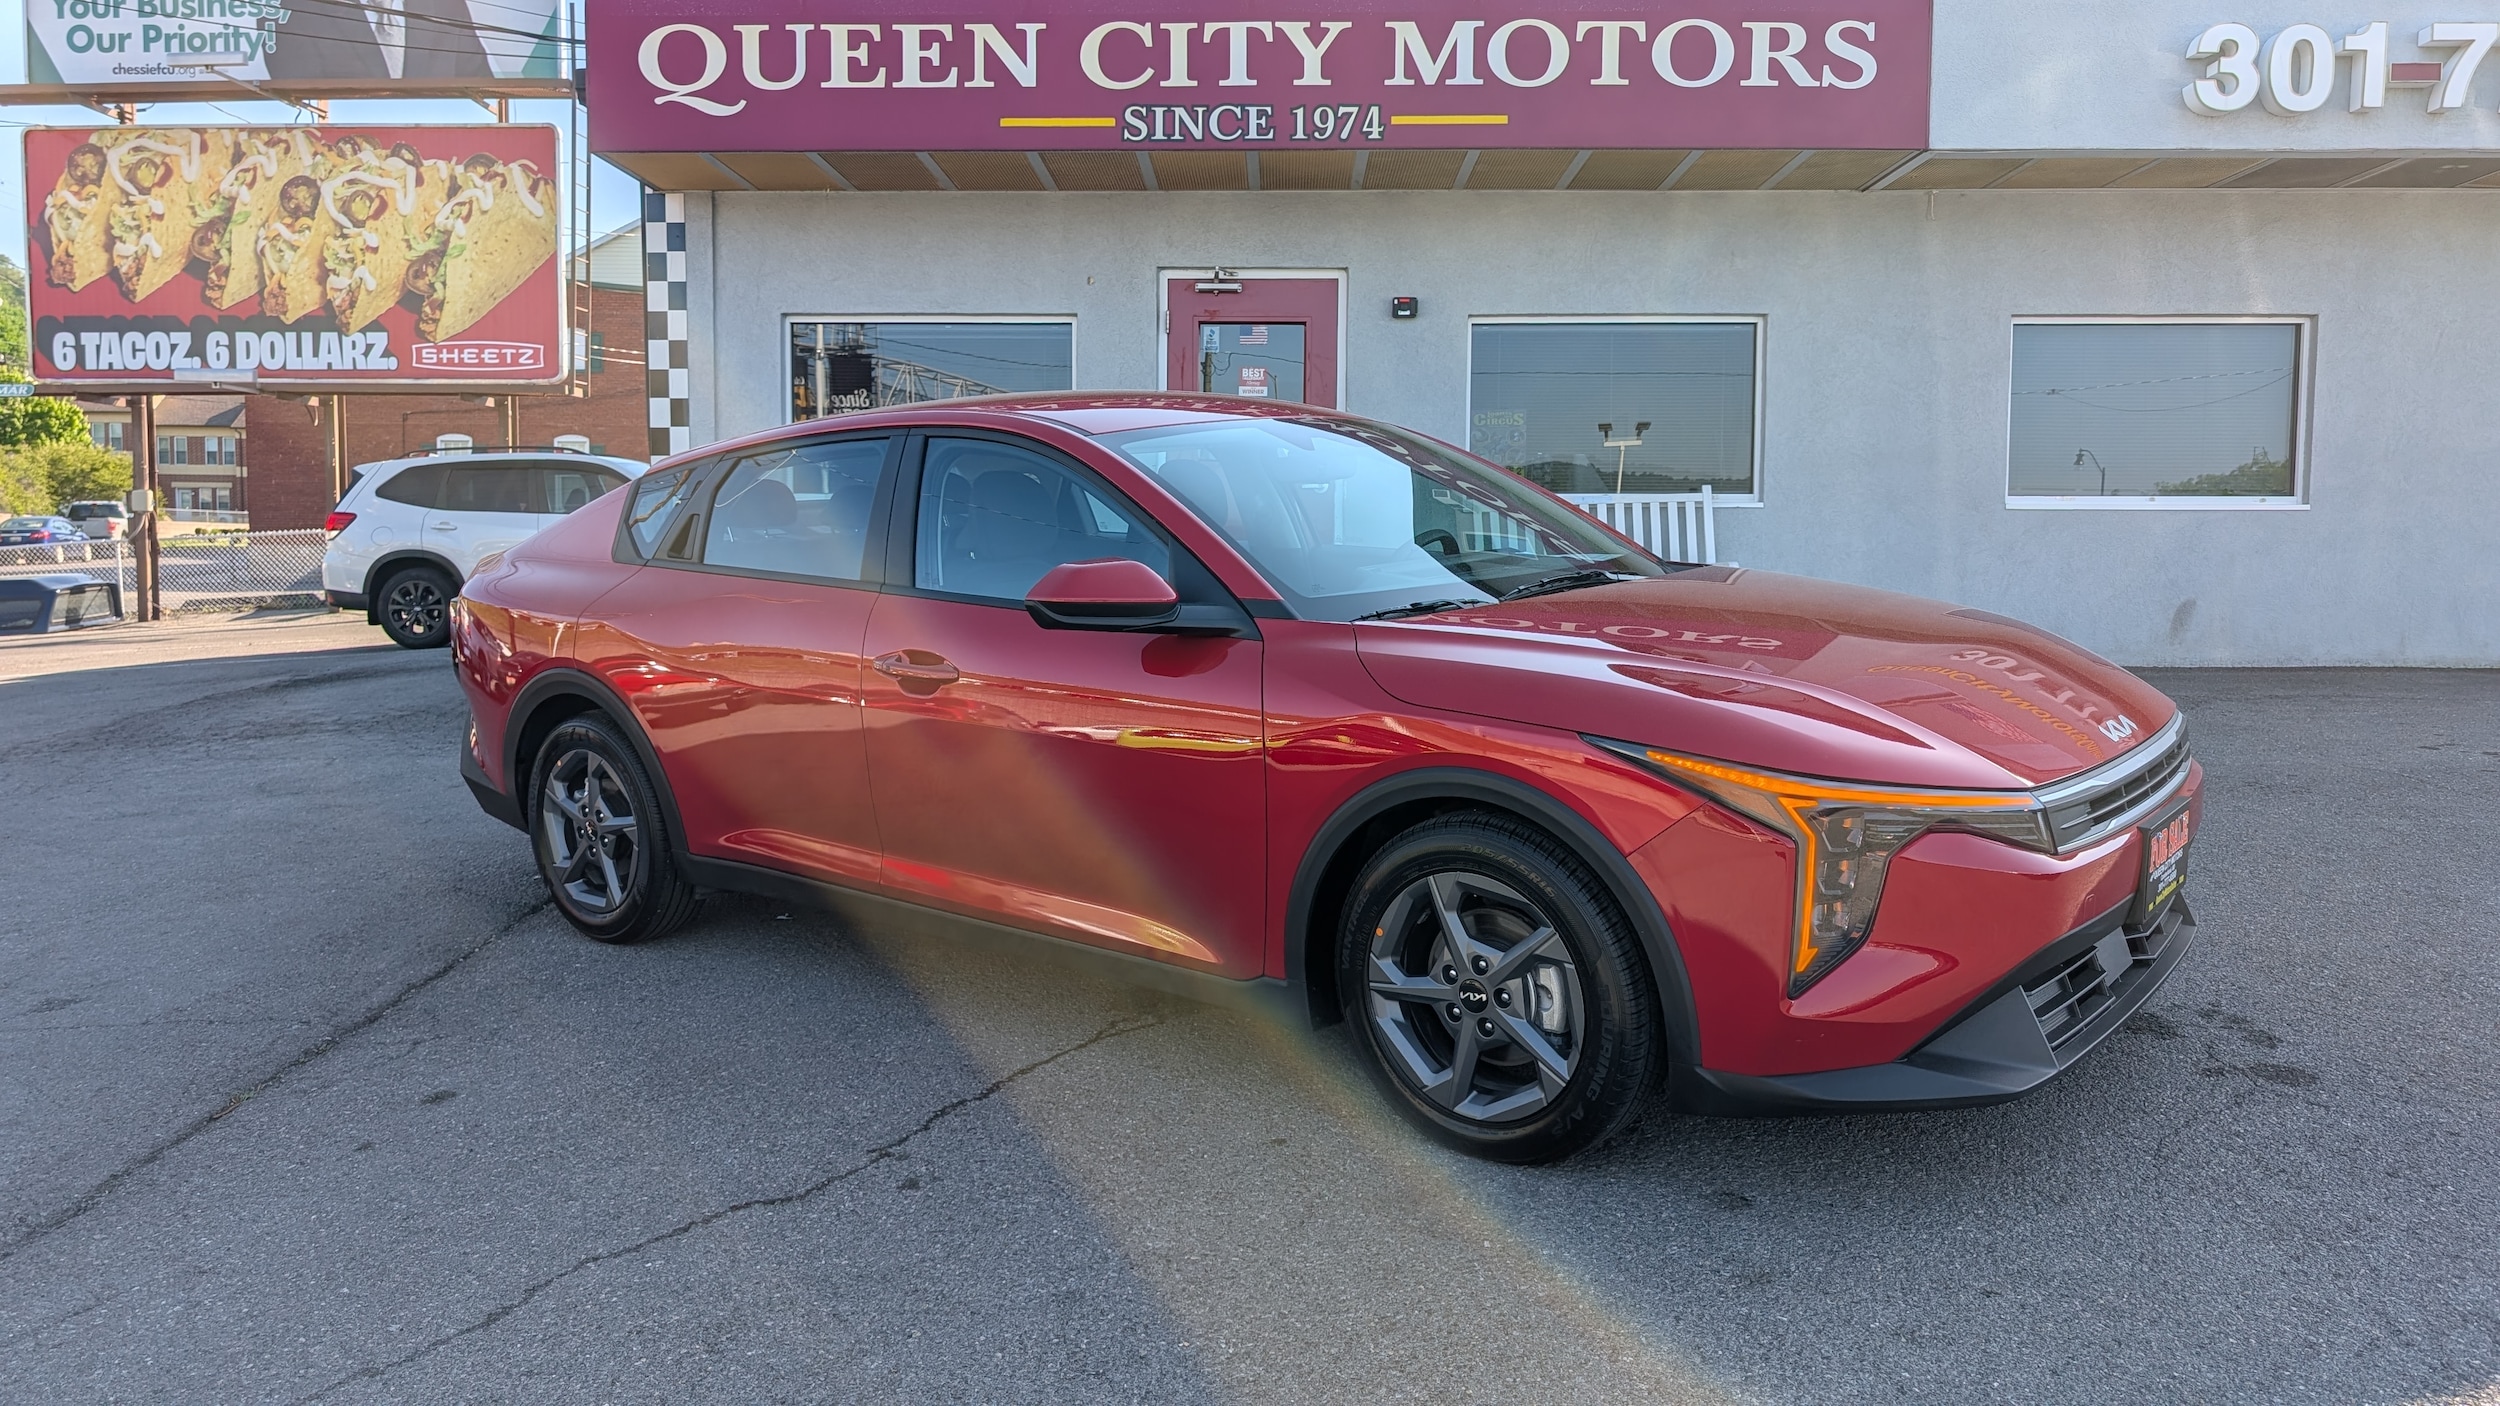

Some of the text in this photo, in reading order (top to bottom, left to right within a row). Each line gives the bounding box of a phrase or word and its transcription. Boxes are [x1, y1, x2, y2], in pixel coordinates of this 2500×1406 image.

[52, 0, 293, 24] Your Business,
[66, 21, 278, 62] Our Priority!
[112, 62, 197, 78] chessiefcu.org
[637, 18, 1878, 117] QUEEN CITY MOTORS
[2182, 20, 2500, 117] 301-7
[1122, 104, 1386, 143] SINCE 1974
[53, 330, 399, 371] 6 TACOZ. 6 DOLLARZ.
[421, 348, 534, 364] SHEETZ
[1242, 368, 1266, 377] BEST
